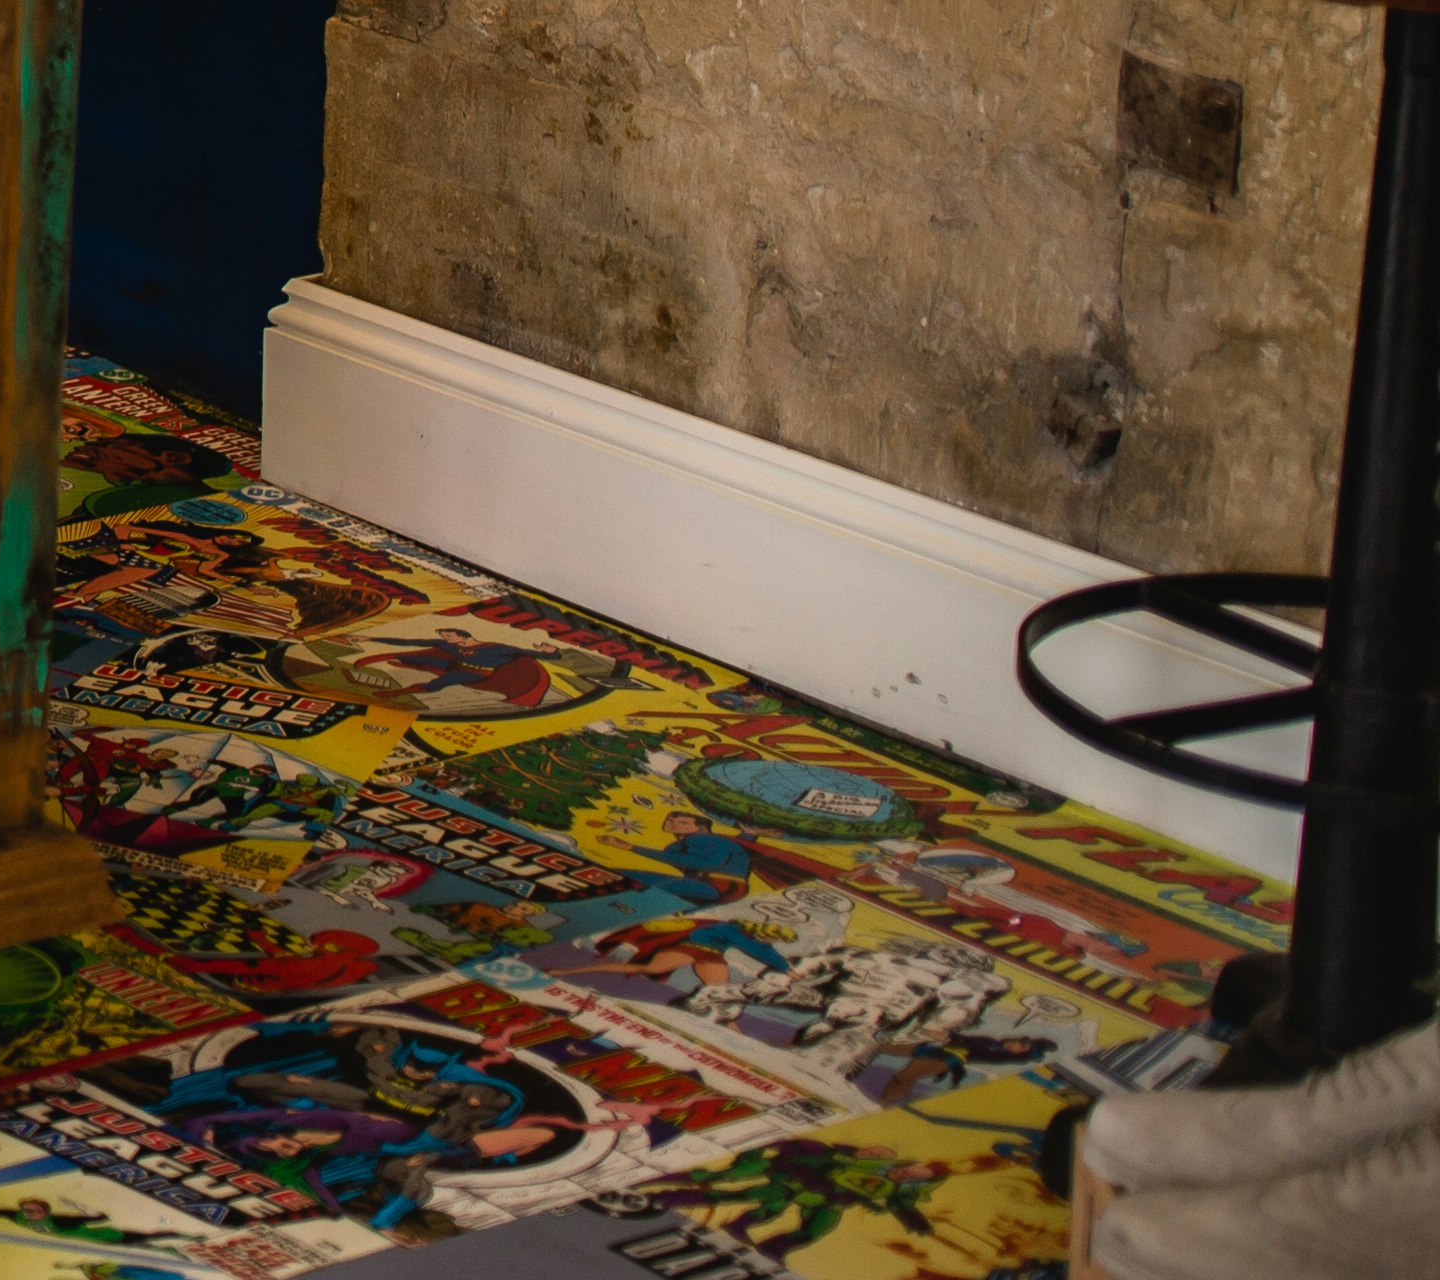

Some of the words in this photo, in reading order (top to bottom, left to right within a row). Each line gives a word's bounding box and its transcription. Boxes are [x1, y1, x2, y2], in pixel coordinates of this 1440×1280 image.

[61, 378, 154, 419] LANTERN
[113, 385, 174, 415] GREEN
[435, 596, 716, 691] SUPERMAN
[72, 677, 320, 727] EAGUE
[90, 663, 336, 714] USTICE
[344, 819, 536, 899] MERICA
[359, 786, 625, 888] JUSTICE
[359, 807, 595, 891] EAGUE
[1016, 824, 1292, 926] FLAS
[16, 1103, 286, 1219] LEAGUE
[46, 1096, 319, 1212] JUSTICE
